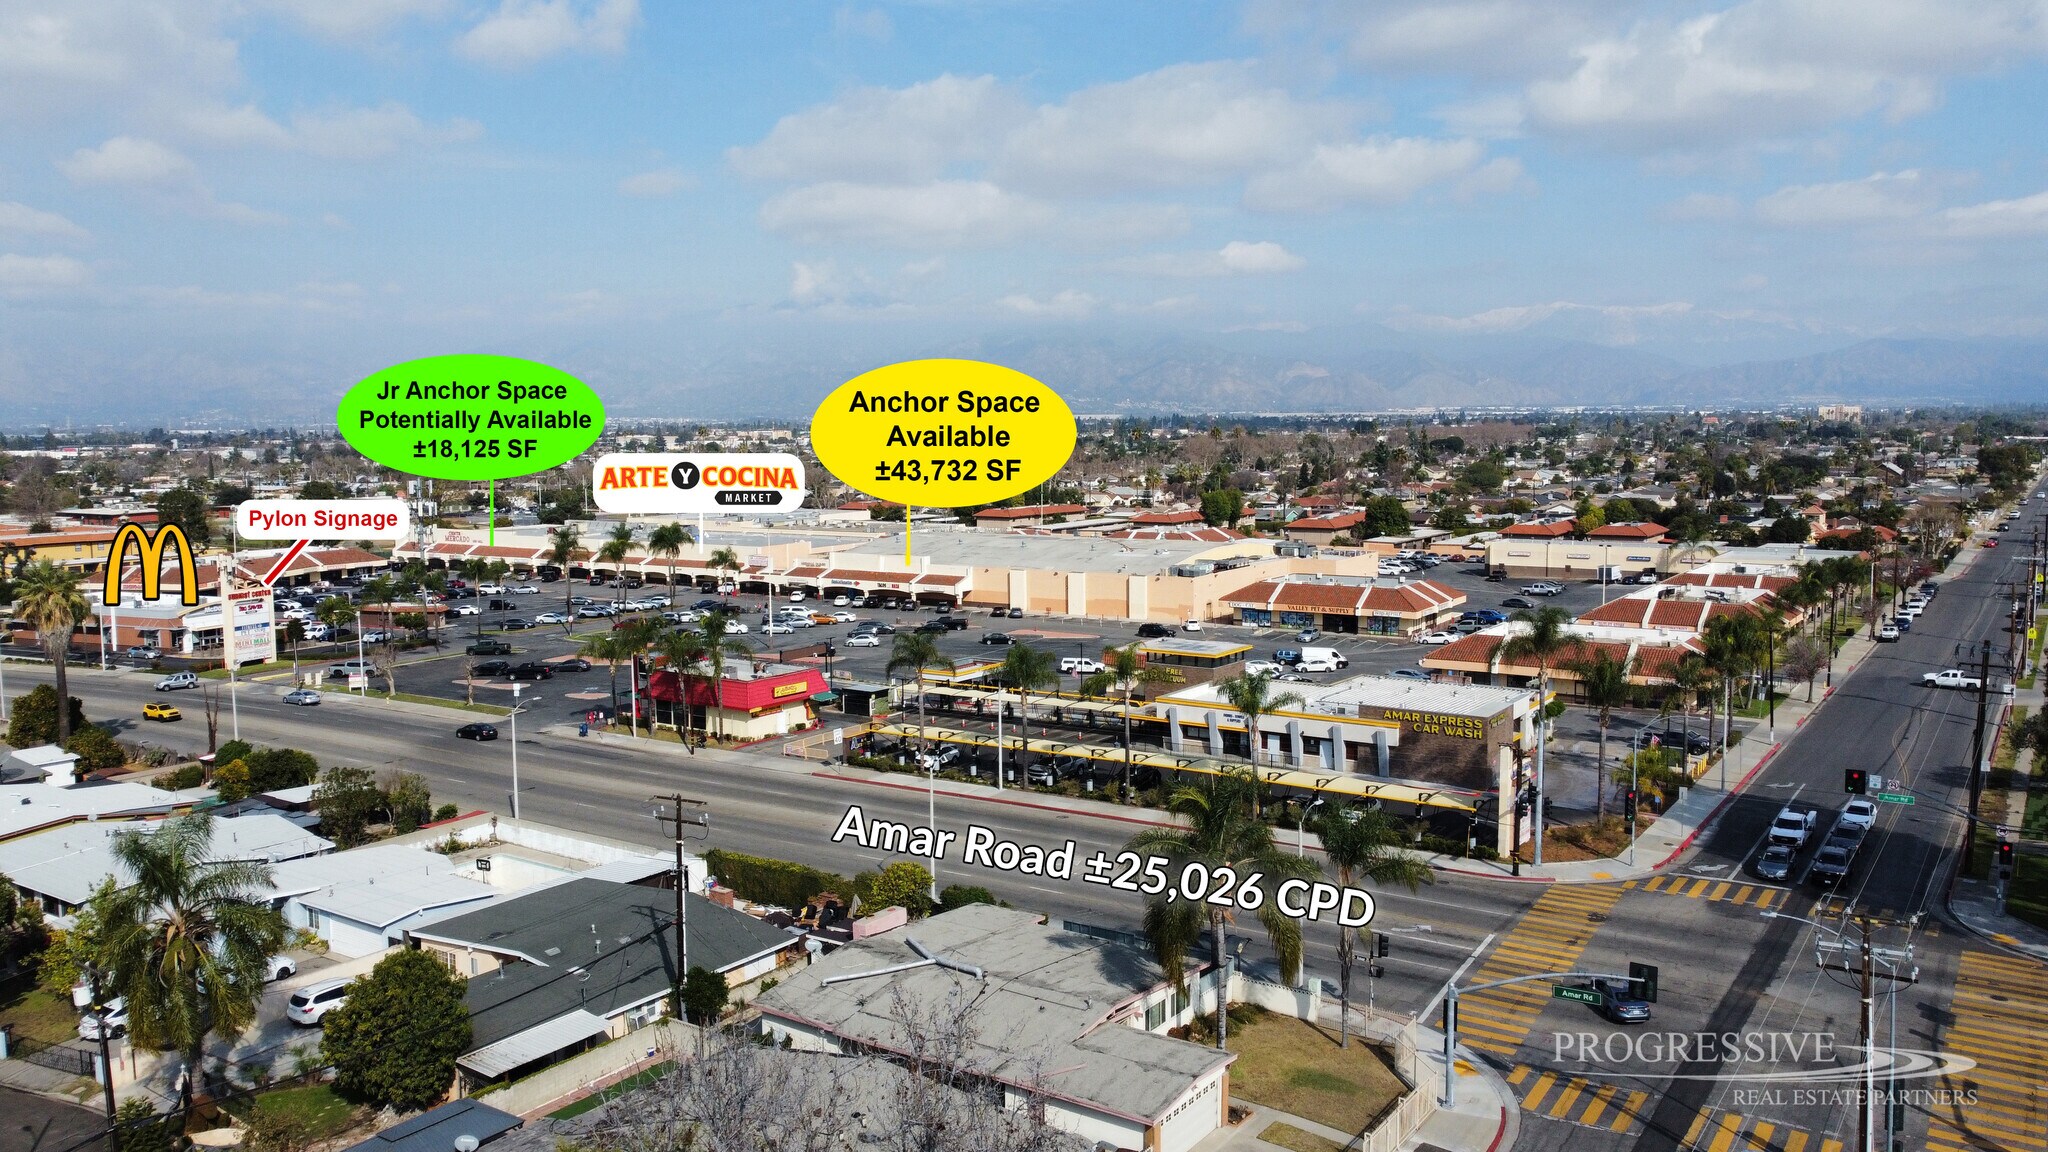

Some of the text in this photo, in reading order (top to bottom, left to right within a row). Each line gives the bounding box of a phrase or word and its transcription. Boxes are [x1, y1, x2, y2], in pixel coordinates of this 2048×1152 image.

[1166, 667, 1183, 675] FREE
[1383, 710, 1420, 722] AMAR
[1424, 714, 1483, 729] EXPRESS
[1413, 723, 1483, 739] CAR WASH
[1562, 990, 1593, 1001] Amar Rd
